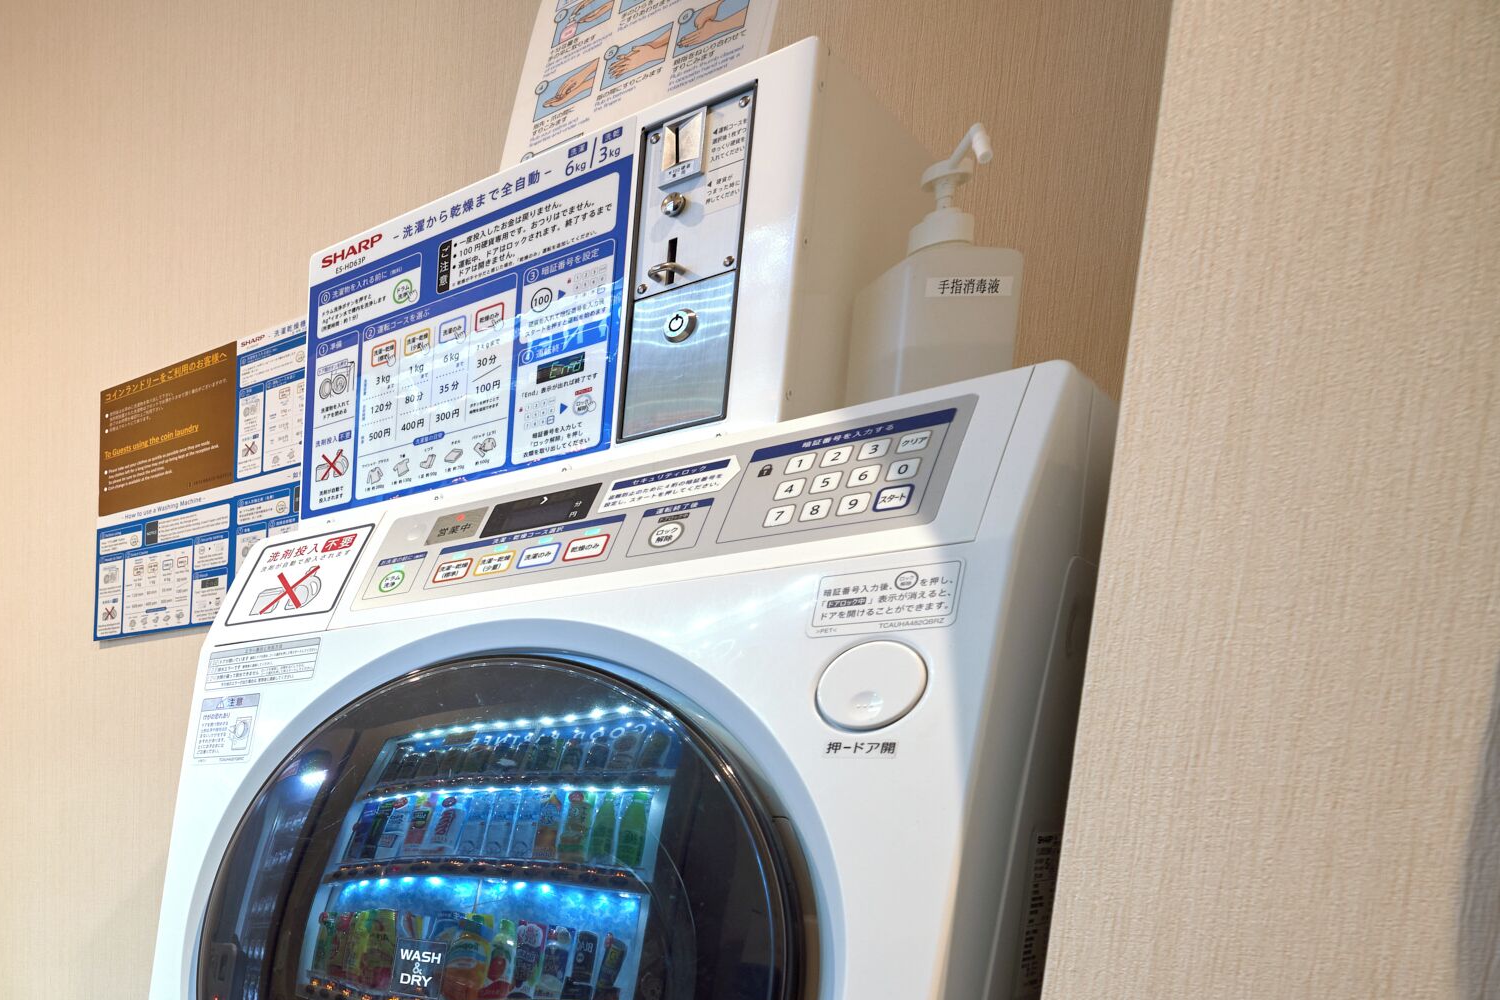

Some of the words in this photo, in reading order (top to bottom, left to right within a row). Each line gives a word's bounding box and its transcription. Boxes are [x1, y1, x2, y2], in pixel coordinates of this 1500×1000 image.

[402, 169, 541, 240] 洗濯から乾燥まで全自動
[459, 201, 564, 245] 一度投入したお金は戻りません。
[321, 233, 383, 269] SHARP
[335, 256, 366, 275] ES-HD63P
[541, 248, 600, 275] 暗証番号を設定
[937, 278, 1001, 295] 手指消毒液
[533, 294, 550, 307] 100
[240, 334, 266, 348] SHARP
[476, 355, 497, 368] 30分
[104, 351, 228, 401] コインランドリーをご利用のお客様へ
[438, 380, 459, 394] 35分
[475, 379, 501, 394] 100円
[370, 400, 393, 414] 120分
[435, 408, 460, 422] 300円
[400, 418, 425, 432] 400円
[112, 446, 132, 457] Guests
[132, 440, 149, 452] using
[149, 436, 160, 445] the
[160, 431, 174, 442] coin
[174, 423, 200, 437] laundry
[368, 428, 391, 441] 500円
[801, 423, 895, 449] 暗証番号を入力する
[797, 459, 803, 468] 1
[830, 451, 842, 462] 2
[868, 444, 879, 455] 3
[901, 435, 928, 447] クリア
[632, 465, 707, 486] セキュリティロック
[784, 484, 794, 494] 4
[820, 477, 830, 488] 5
[858, 470, 869, 481] 6
[897, 464, 909, 475] 0
[157, 501, 179, 514] Washing
[180, 496, 202, 509] Machine
[573, 500, 583, 508] 分
[654, 501, 700, 515] 運転終了後
[775, 511, 785, 522] 7
[810, 504, 820, 516] 8
[848, 498, 858, 510] 9
[878, 492, 907, 505] スタート
[568, 510, 578, 519] 円
[655, 526, 679, 537] ロック
[654, 534, 674, 545] 解除
[266, 542, 320, 564] 洗剤投入
[324, 534, 357, 551] 不要
[570, 542, 601, 554] 乾燥のみ
[259, 548, 352, 573] 洗剤が自動で投入されます
[523, 550, 552, 562] 洗濯のみ
[382, 581, 397, 590] 洗浄
[384, 574, 401, 583] ドラム
[820, 601, 949, 621] ドアを開けることができます。
[399, 948, 442, 965] WASH
[412, 961, 423, 976] &
[399, 973, 433, 988] DRY
